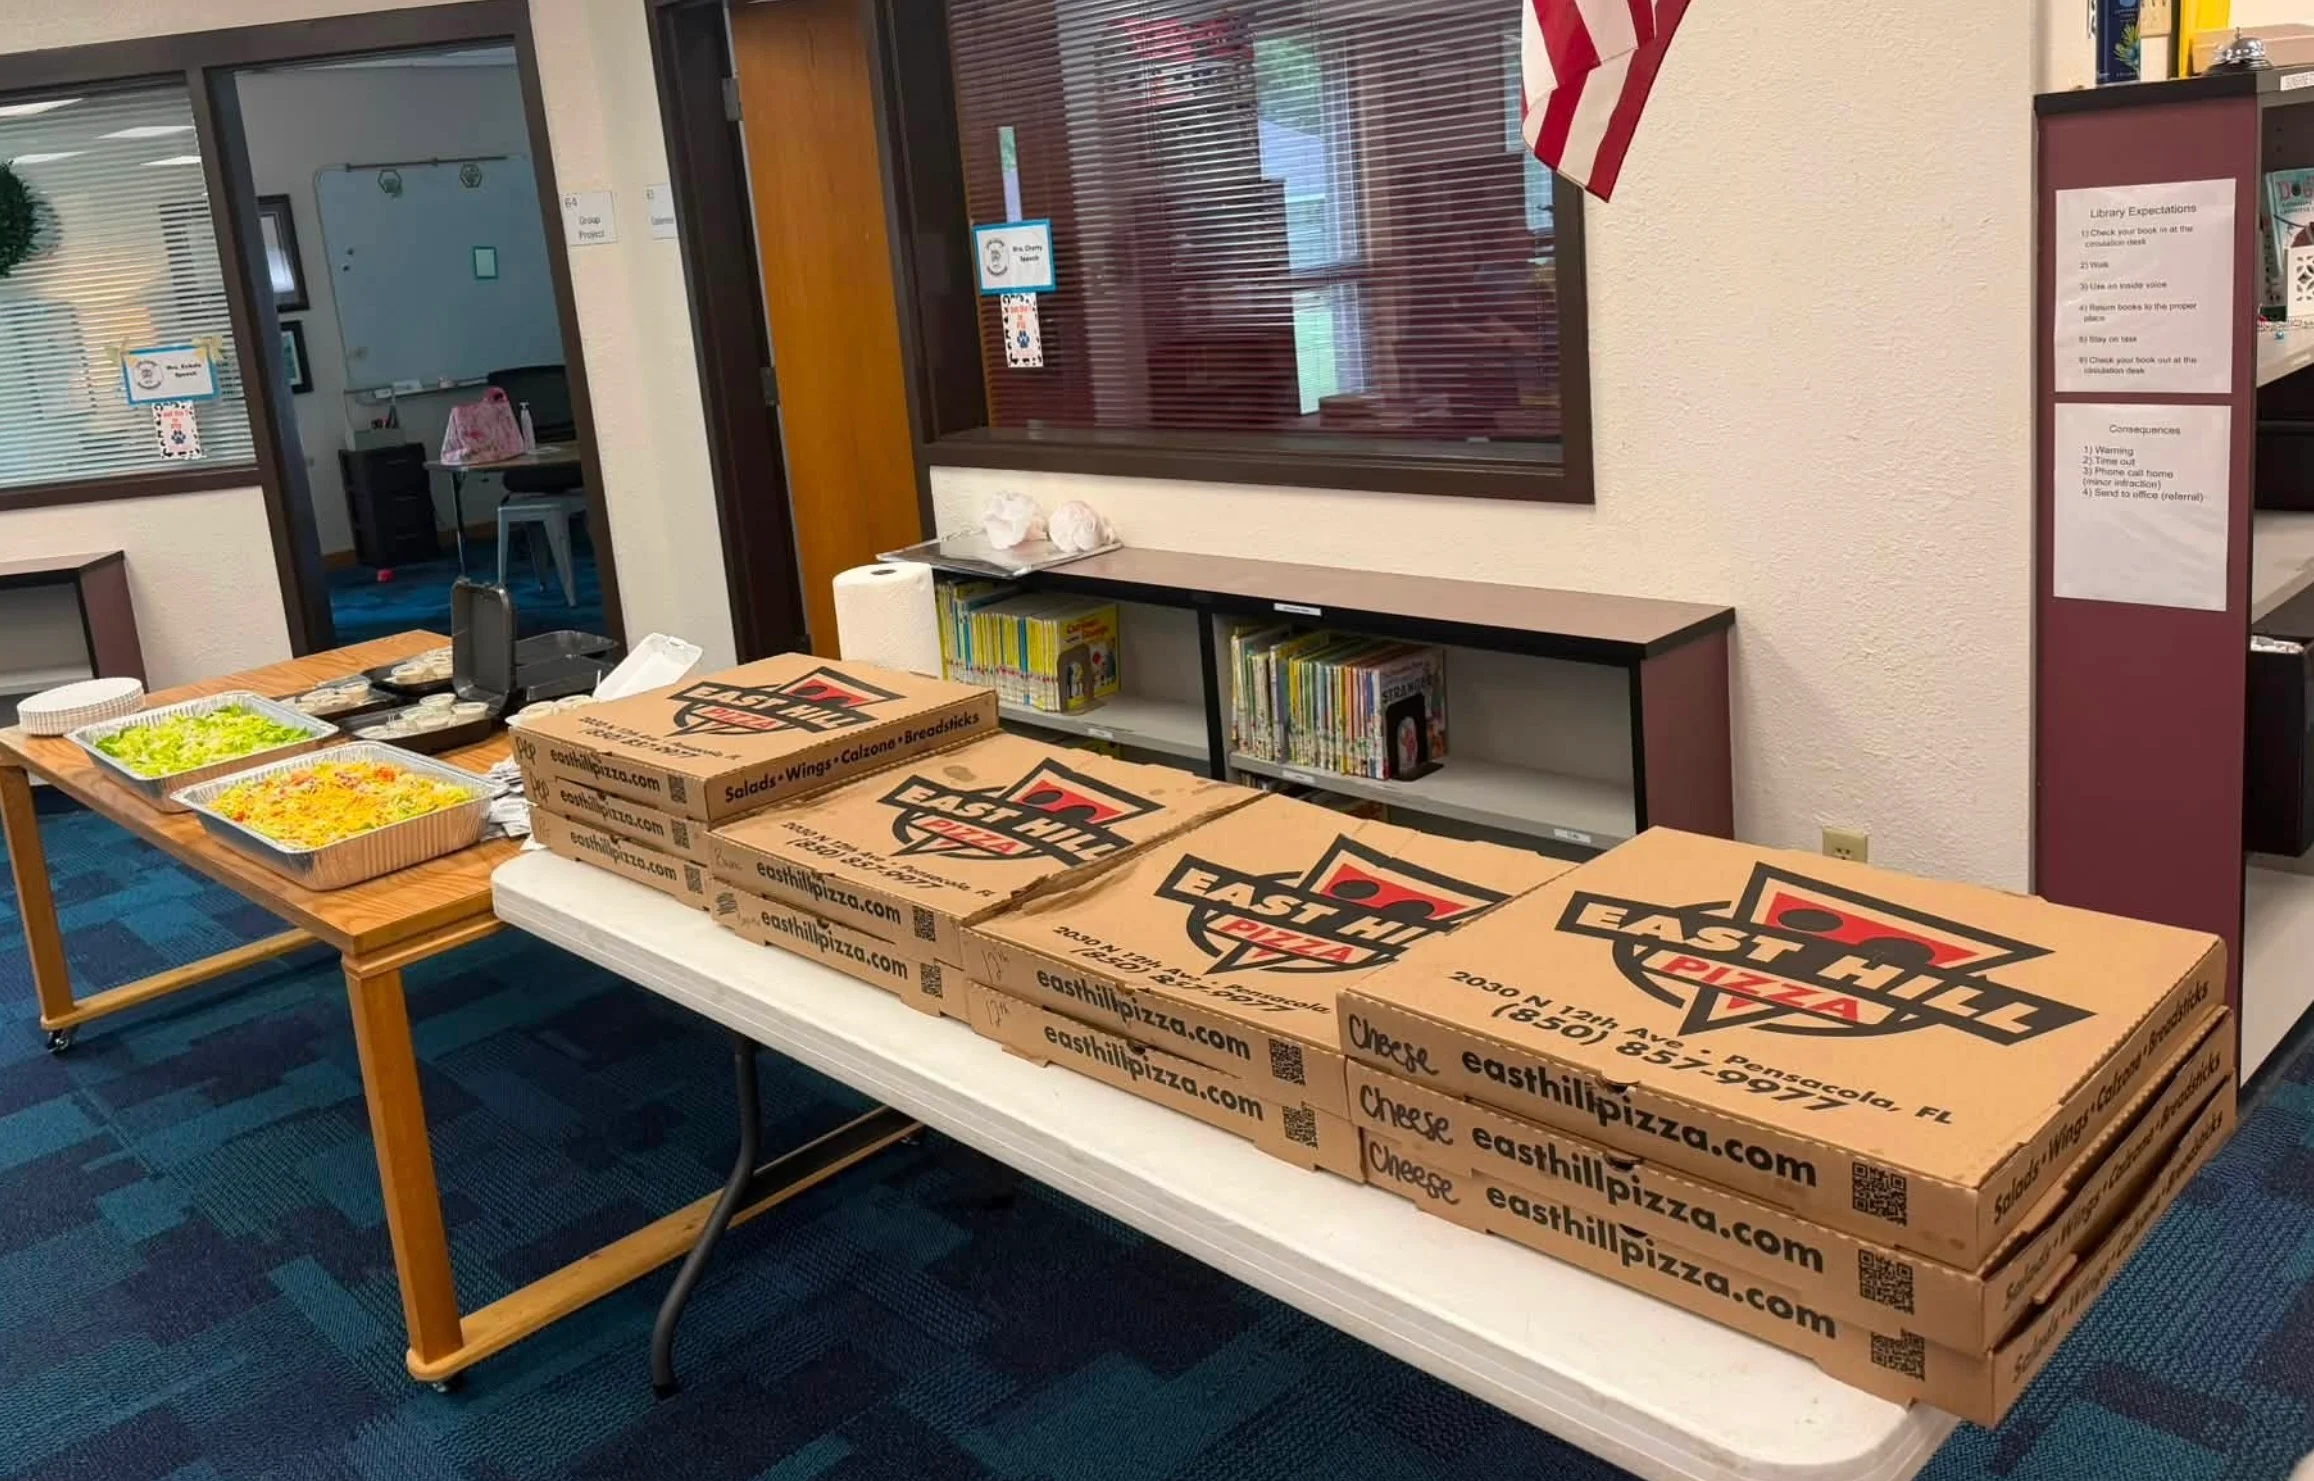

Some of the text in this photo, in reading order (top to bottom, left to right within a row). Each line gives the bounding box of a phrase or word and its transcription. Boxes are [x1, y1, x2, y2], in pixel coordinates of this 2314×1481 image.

[2090, 204, 2197, 219] Library Expectations
[2090, 228, 2115, 236] Check
[2118, 228, 2135, 237] your
[2179, 225, 2193, 233] the
[2084, 238, 2146, 248] circulation desk
[2089, 261, 2109, 269] Walk
[2089, 282, 2105, 290] Use
[2120, 282, 2143, 290] inside
[2146, 281, 2167, 289] voice
[2089, 303, 2116, 311] Return
[2169, 303, 2197, 312] proper
[2089, 336, 2107, 344] Stay
[2089, 356, 2114, 364] Check
[2116, 357, 2134, 366] your
[2135, 356, 2155, 364] book
[2083, 445, 2134, 457] 1) Warning
[2109, 424, 2181, 436] Consequences
[2082, 456, 2136, 466] 2) Time out
[2082, 466, 2174, 479] 3) Phone call home
[2082, 478, 2162, 491] (minor infraction)
[2082, 488, 2204, 503] 4) Send to office (referral)
[683, 685, 858, 729] EAST HILL
[701, 706, 779, 730] PIZZA
[550, 748, 661, 792] easthillpizza.com
[725, 711, 980, 804] Salads Wings Calzone Breadsticks
[560, 788, 664, 837] easthillpizza.com
[895, 785, 1116, 860] EAST HILL
[920, 818, 1019, 854] PIZZA
[570, 830, 677, 880] easthillpizza.com
[786, 838, 944, 889] (850) 857-9977
[757, 861, 901, 924] easthillpizza.com
[1173, 868, 1429, 952] EAST HI
[761, 910, 908, 980] easthillpizza.com
[1053, 925, 1100, 946] 2030
[1100, 943, 1120, 954] N
[1120, 951, 1162, 969] 12th
[1218, 917, 1359, 964] PIZZA
[1069, 947, 1297, 1013] (850) 857-9977
[1576, 900, 2039, 1034] EAST HILL
[1658, 955, 1861, 1022] PIZZA
[1036, 968, 1251, 1061] easthillpizza.com
[1348, 1012, 1440, 1077] Cheese
[1448, 971, 1955, 1126] 2030 N 12th Ave Pensacola, FL
[1489, 999, 1851, 1114] (850) 857-9977
[1044, 1023, 1264, 1121] easthillpizza.com
[2160, 1051, 2221, 1129] Breadsticks
[1360, 1083, 1454, 1146] Cheese
[1461, 1047, 1817, 1188] easthillpizza.com
[1994, 980, 2209, 1224] Salads Wings Calzone Breadsticks
[1368, 1137, 1461, 1206] Cheese
[1472, 1124, 1824, 1274] easthillpizza.com
[1486, 1183, 1836, 1340] easthillpizza.com
